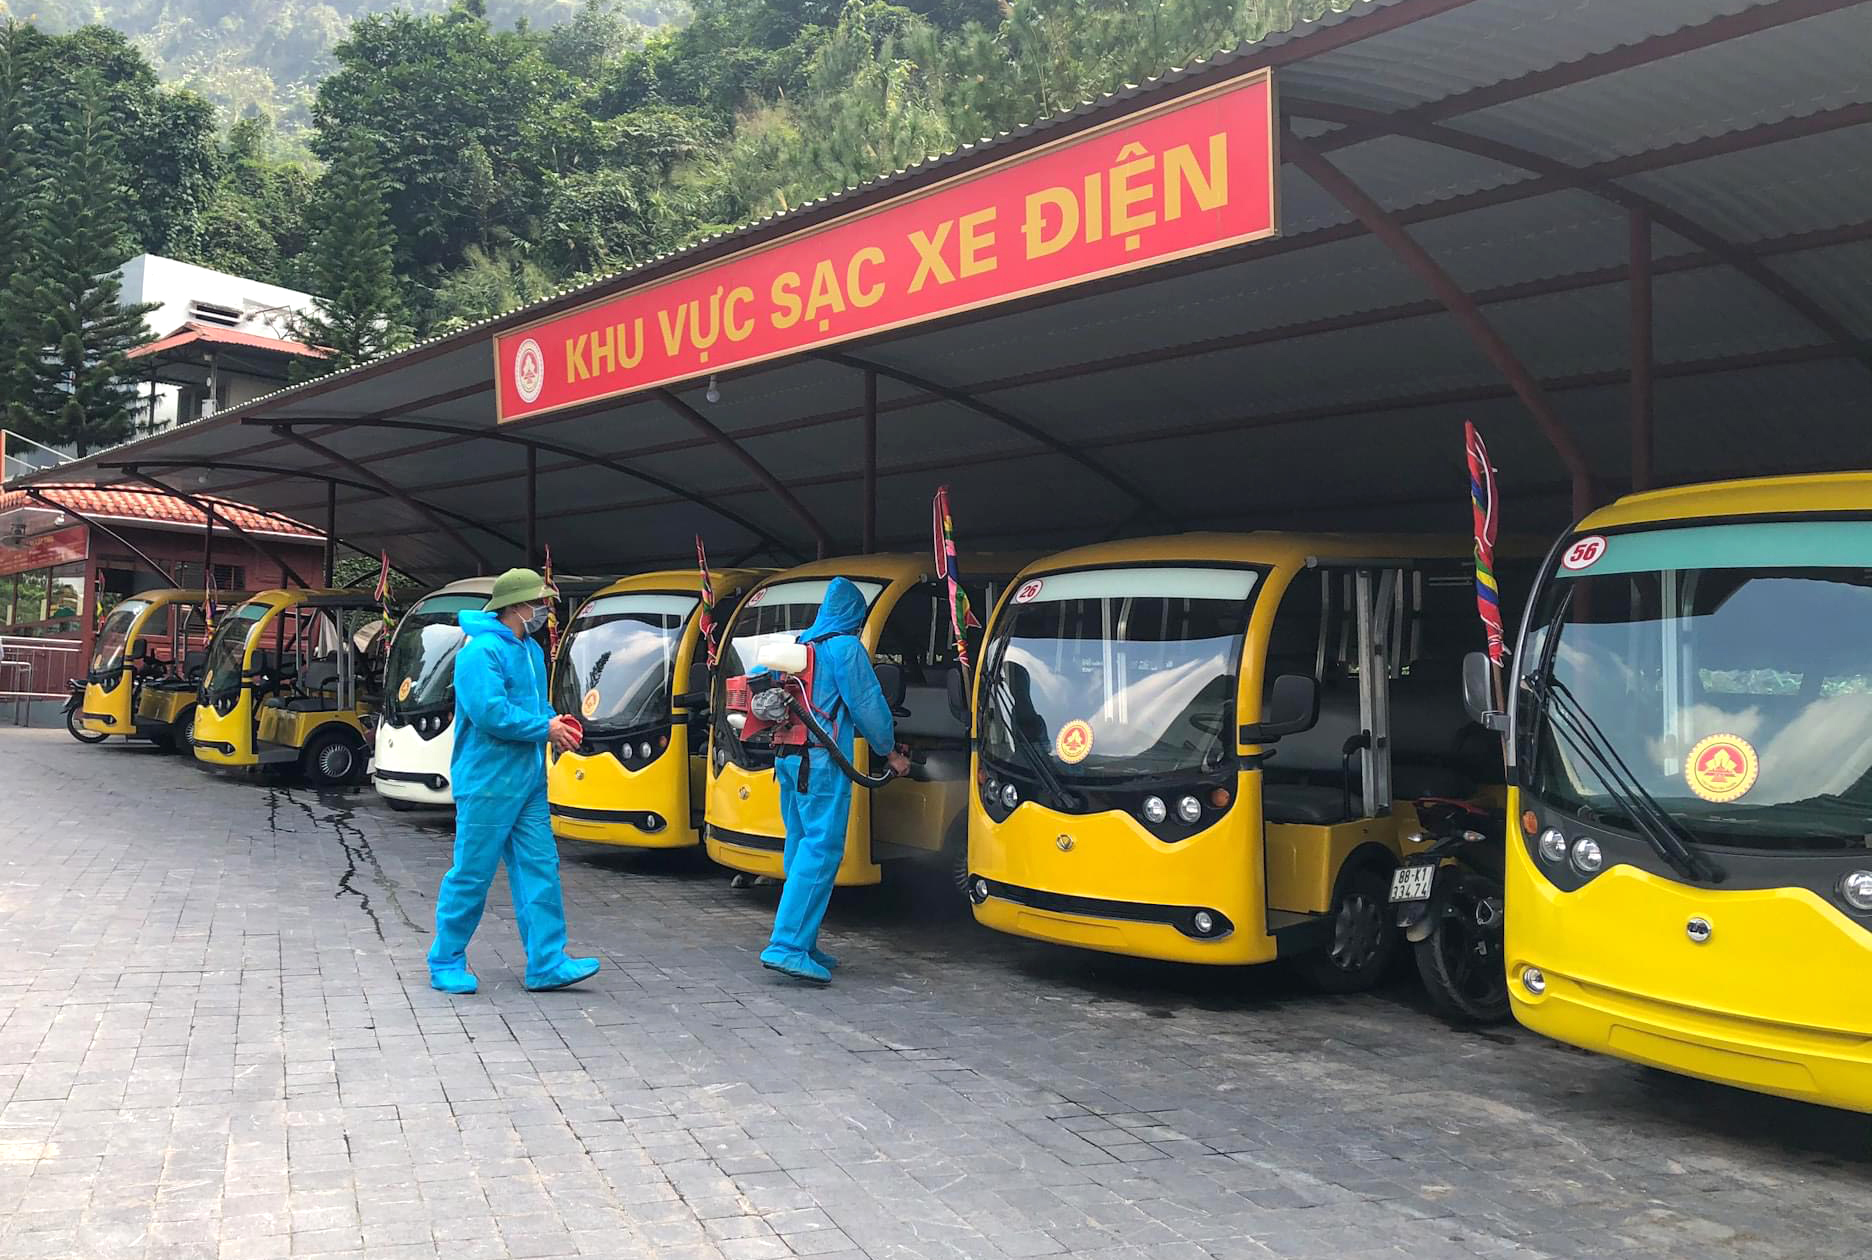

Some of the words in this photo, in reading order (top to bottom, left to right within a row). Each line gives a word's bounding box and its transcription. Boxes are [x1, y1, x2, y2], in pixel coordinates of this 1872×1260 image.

[566, 317, 644, 384] KHU
[657, 285, 755, 362] VỰC
[770, 256, 886, 332] SẠC
[907, 206, 998, 295] XE
[1021, 131, 1228, 261] ĐIỆN
[1570, 542, 1599, 562] 56
[1019, 584, 1038, 598] 26
[1398, 867, 1428, 884] 88-K1
